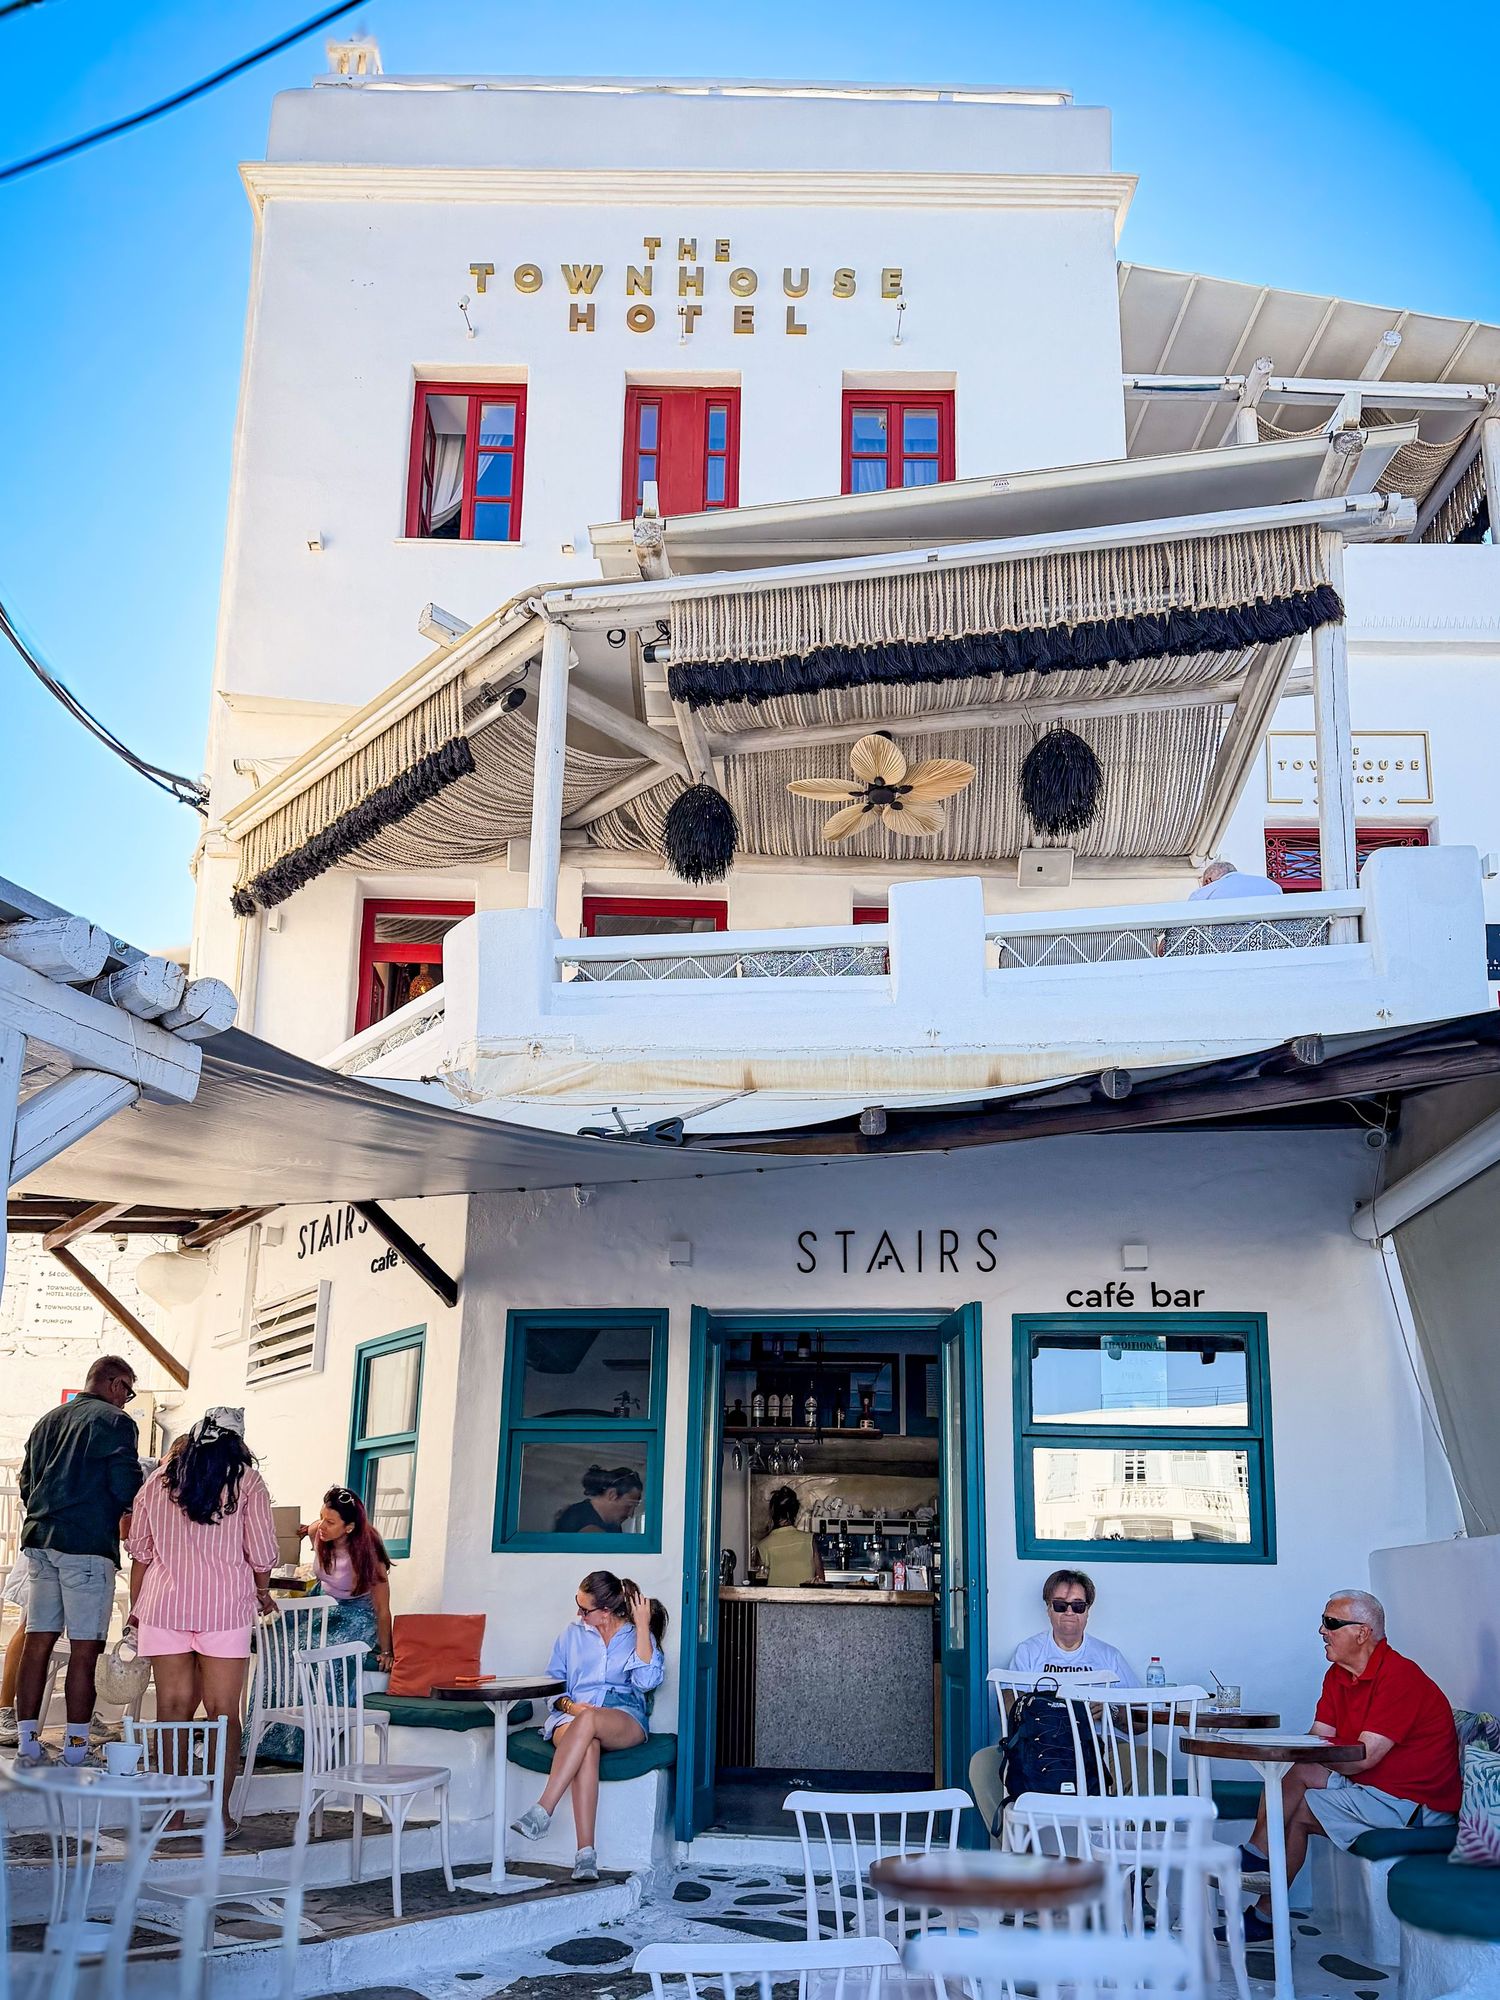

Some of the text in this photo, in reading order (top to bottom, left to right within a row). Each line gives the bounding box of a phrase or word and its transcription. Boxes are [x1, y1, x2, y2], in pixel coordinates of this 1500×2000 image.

[643, 237, 731, 262] THE
[469, 263, 904, 299] TOWNHOUSE
[568, 303, 808, 335] HOTEL
[796, 1229, 998, 1274] STAIRS
[1066, 1282, 1206, 1308] café bar
[1103, 1341, 1163, 1350] TRADITIONAL
